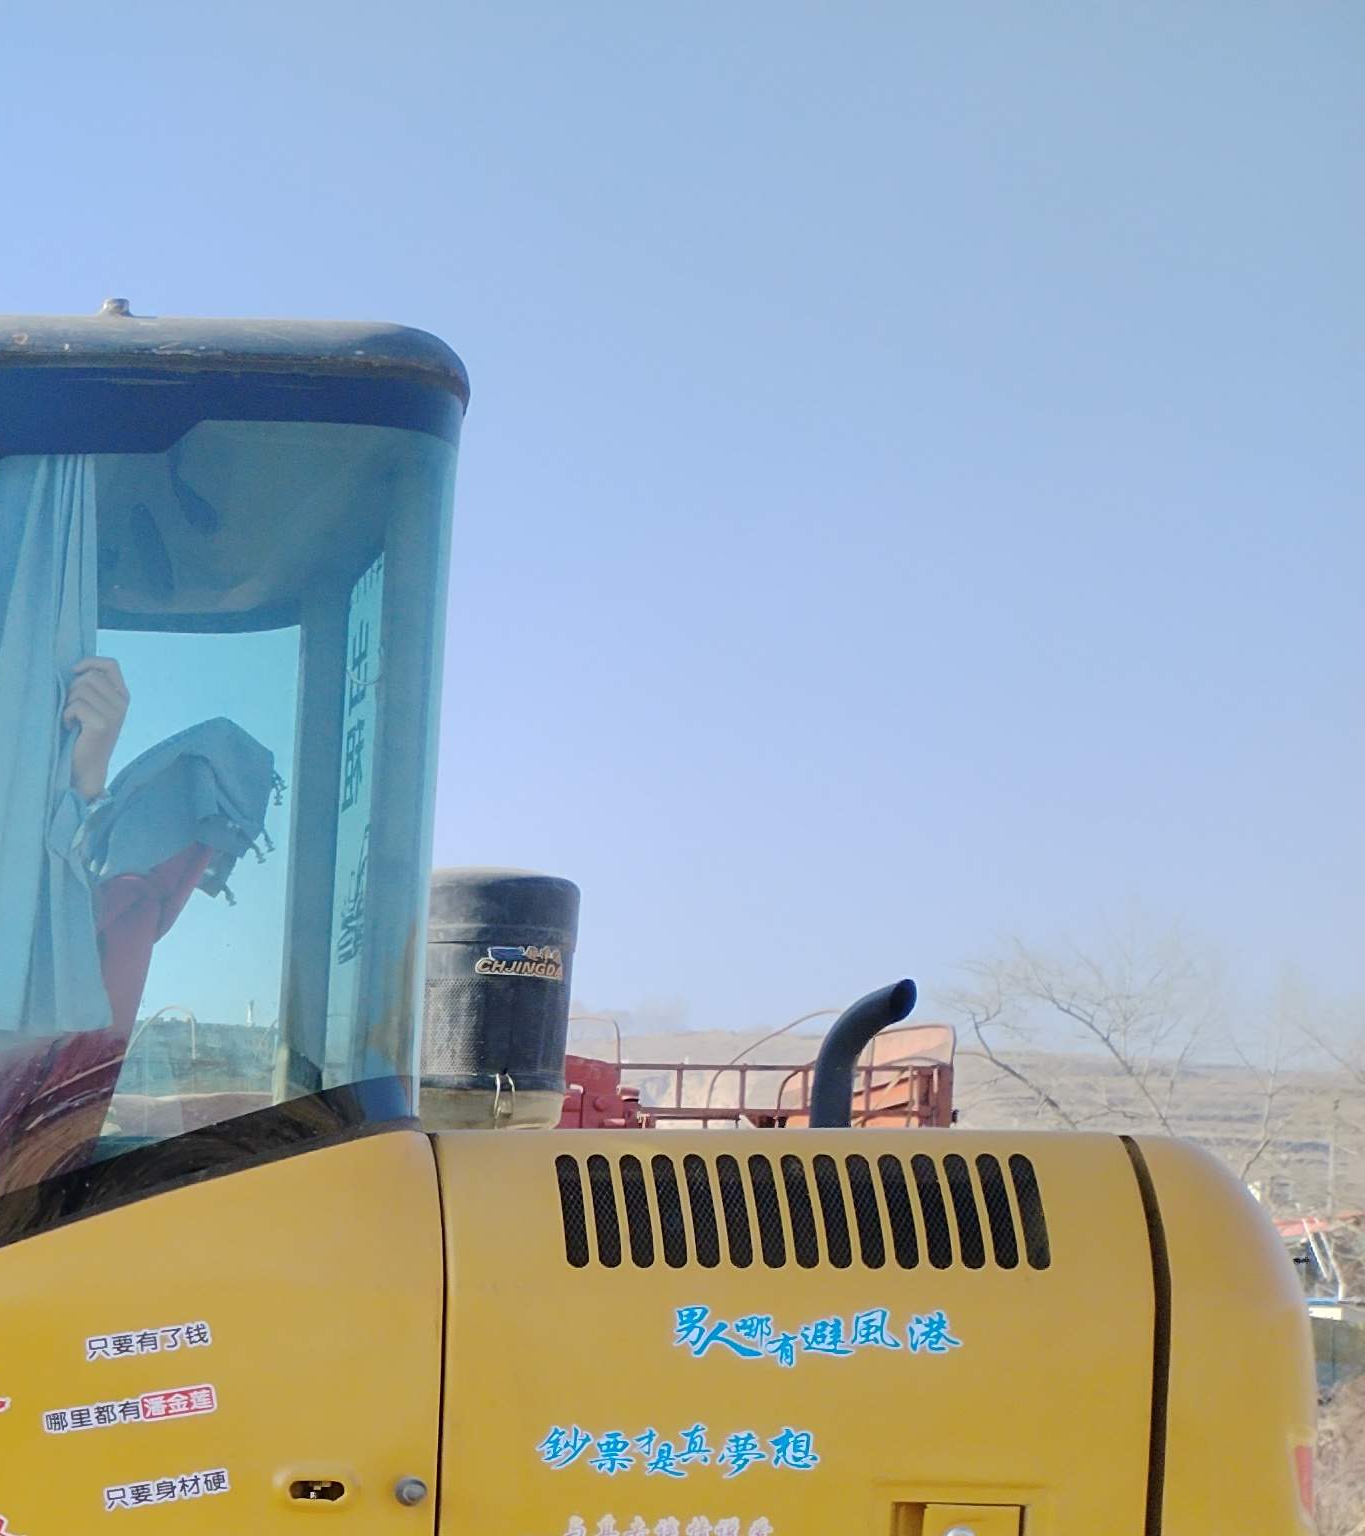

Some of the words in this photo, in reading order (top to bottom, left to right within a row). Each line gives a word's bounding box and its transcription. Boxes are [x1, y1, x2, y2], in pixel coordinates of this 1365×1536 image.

[86, 1322, 211, 1361] 只要有了钱
[44, 1385, 217, 1433] 哪里都有潘金莲
[104, 1468, 230, 1511] 只要身材硬
